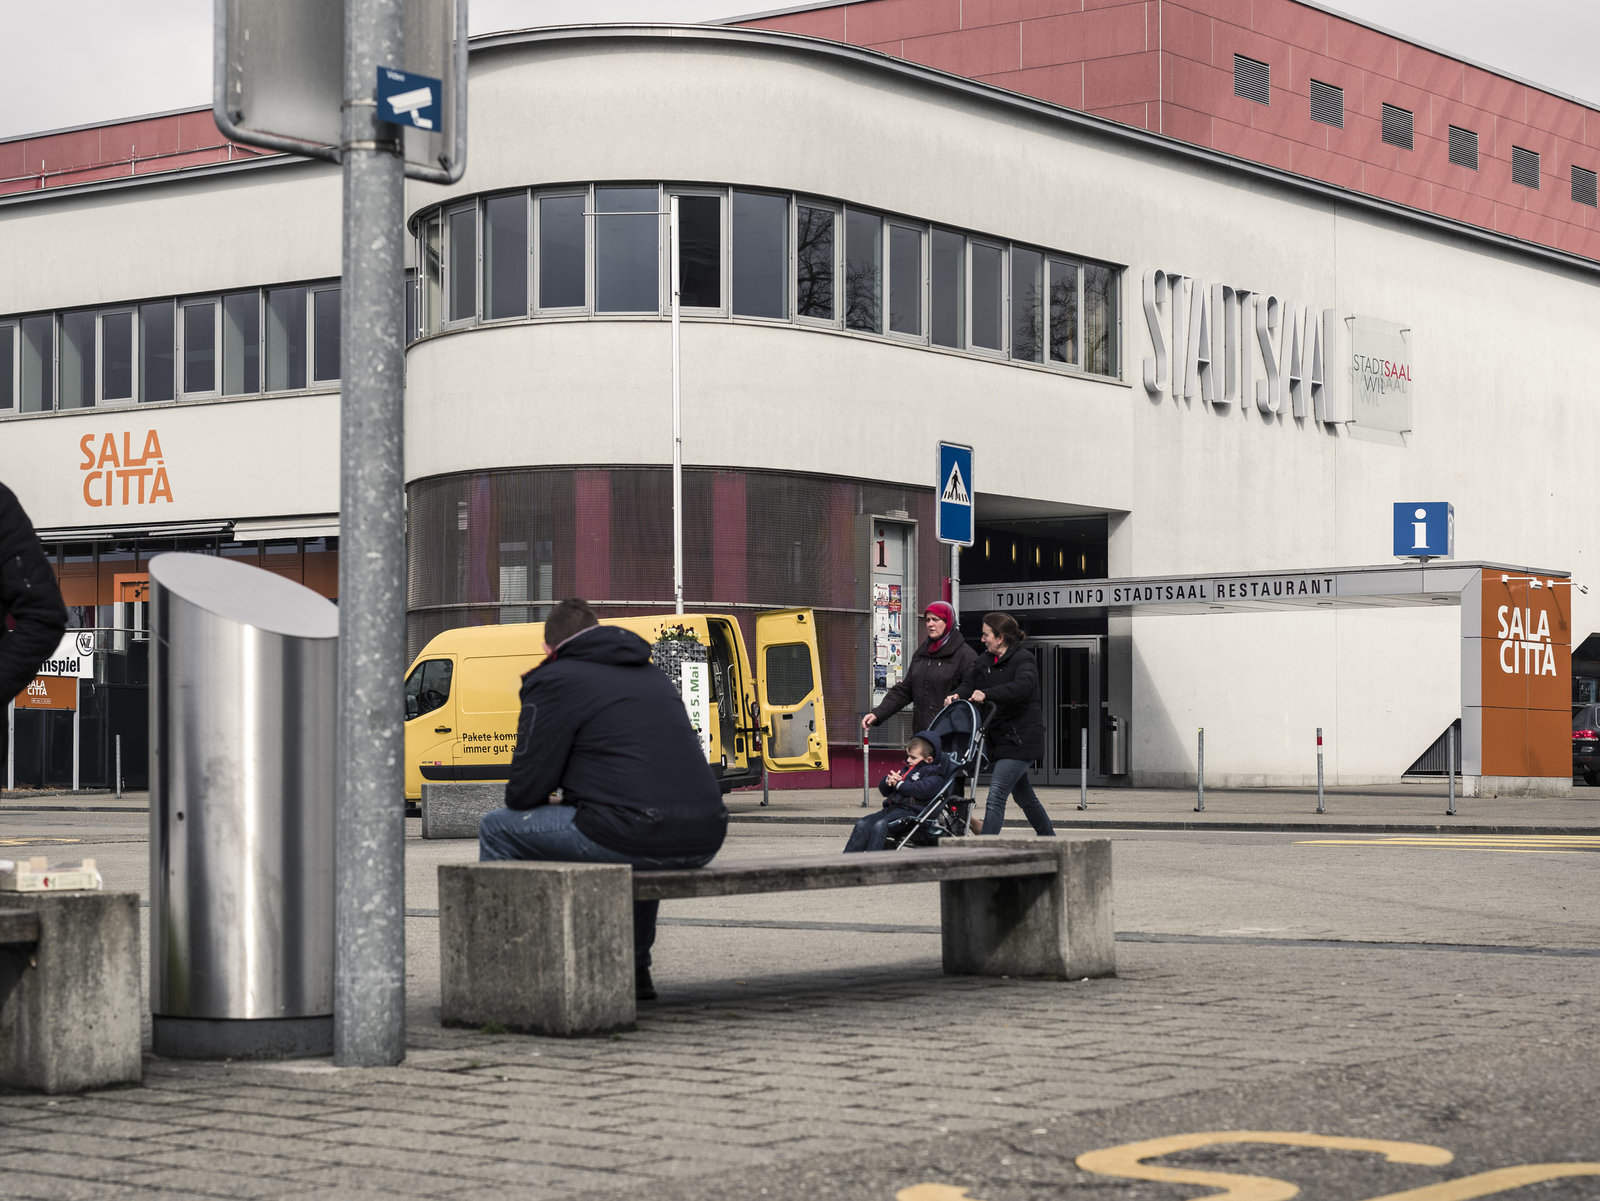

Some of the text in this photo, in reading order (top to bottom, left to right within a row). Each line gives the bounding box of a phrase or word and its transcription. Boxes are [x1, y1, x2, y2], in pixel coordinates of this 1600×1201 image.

[1142, 268, 1345, 424] STADTSAAL
[1353, 354, 1412, 382] STADTSAAL
[1364, 375, 1385, 394] WIL
[80, 429, 163, 470] SALA
[83, 460, 173, 507] CITTÀ
[997, 579, 1333, 607] TOURIST INFO STADTSAAL RESTAURANT
[1497, 605, 1550, 642] SALA
[1500, 638, 1557, 676] CITTÀ
[690, 666, 700, 692] Mai
[462, 732, 492, 742] Pakete
[463, 744, 491, 754] immer
[493, 744, 509, 755] gut
